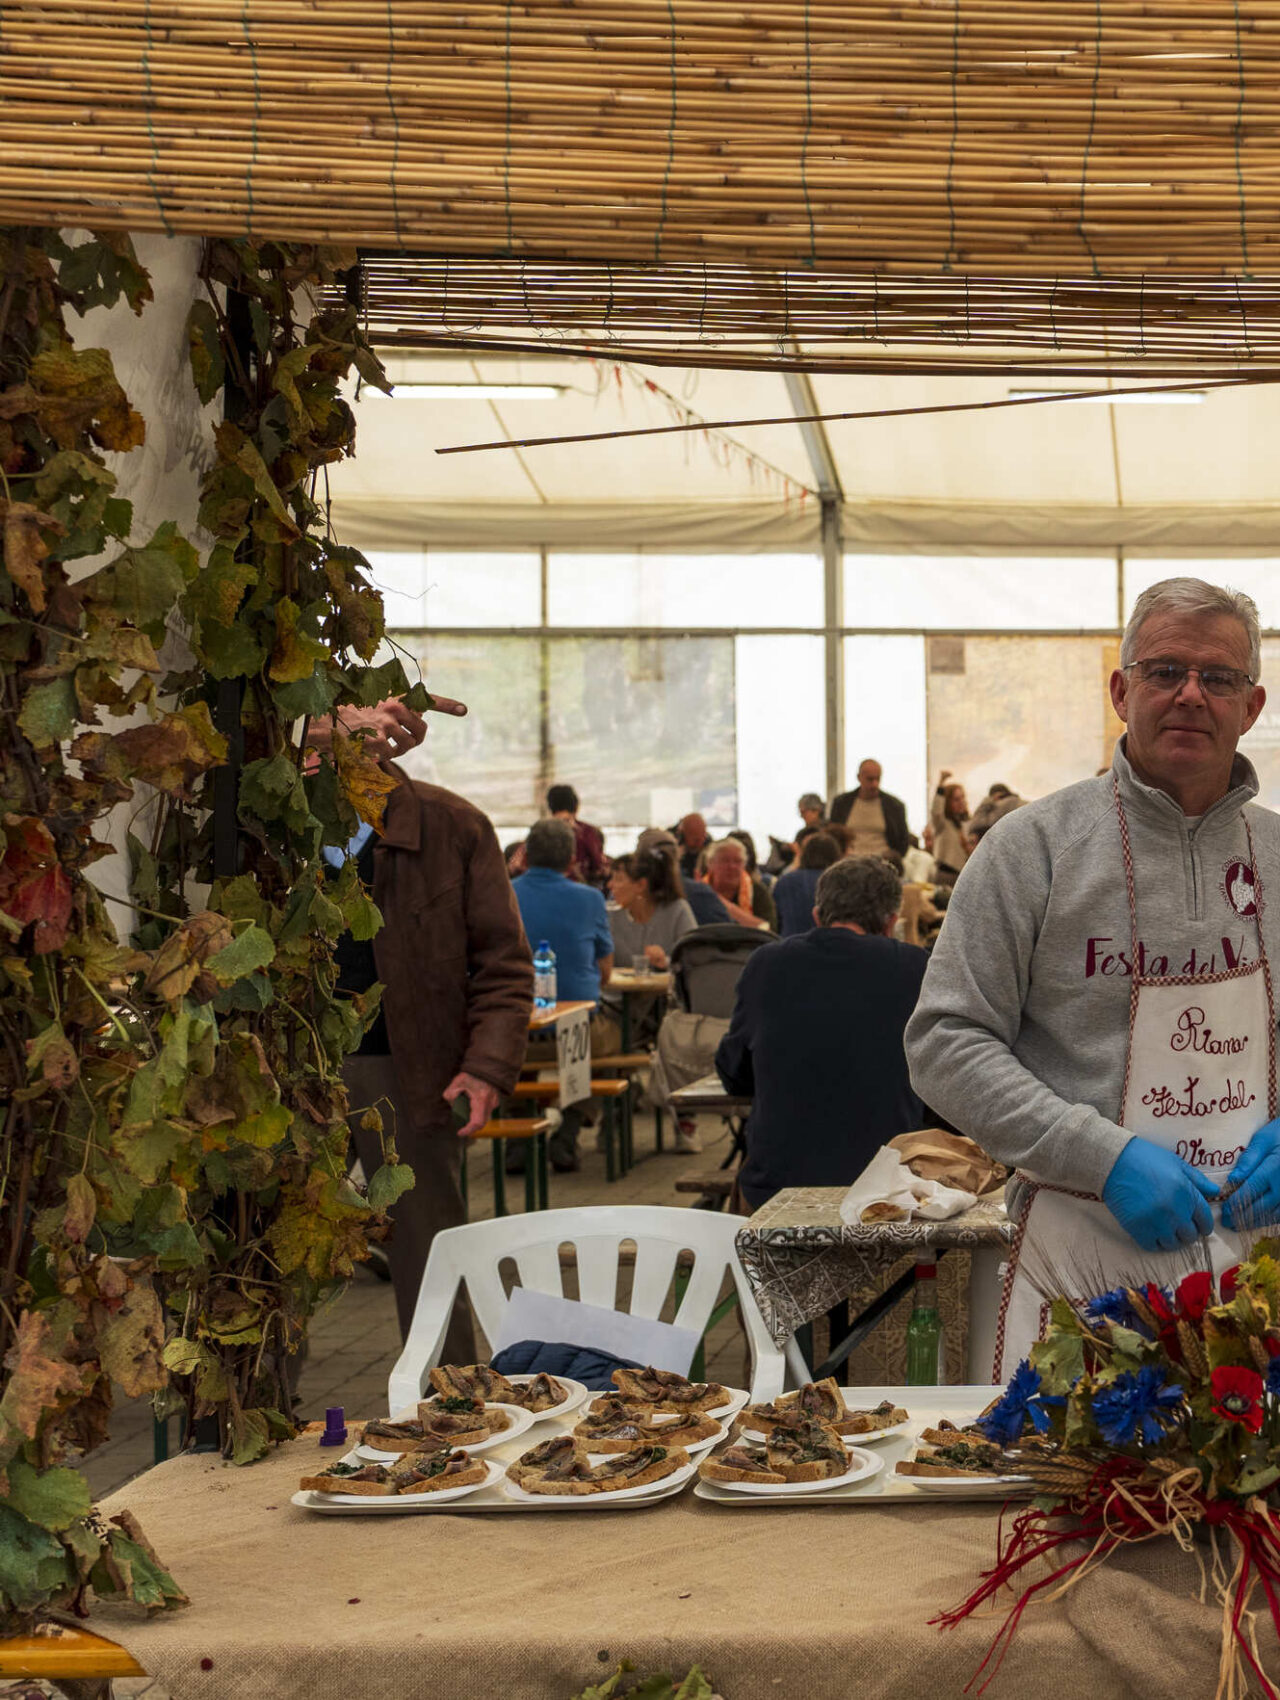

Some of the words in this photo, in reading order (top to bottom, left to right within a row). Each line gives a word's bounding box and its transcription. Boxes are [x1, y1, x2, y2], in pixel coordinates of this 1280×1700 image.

[1086, 937, 1174, 979] Festa
[1182, 948, 1217, 975] del
[1219, 1078, 1256, 1113] del
